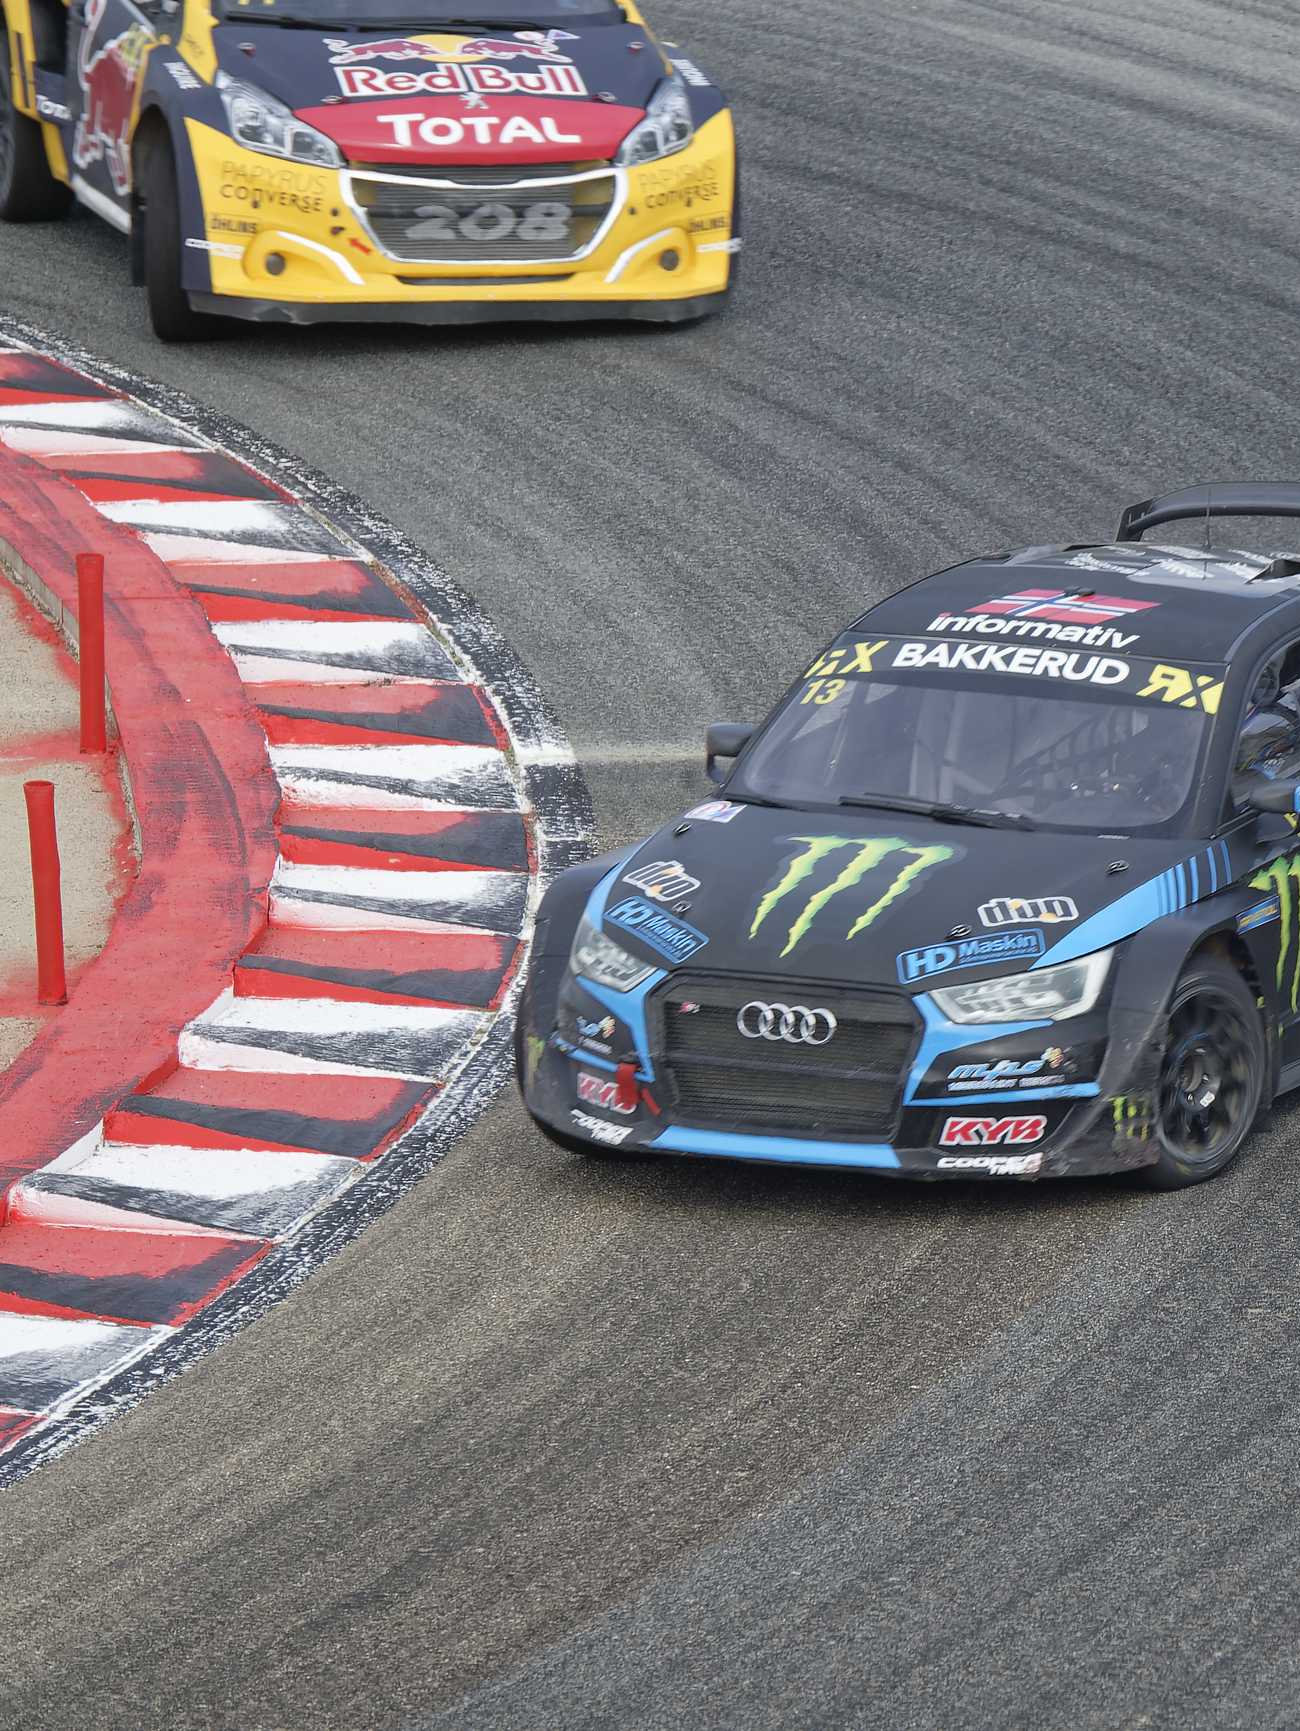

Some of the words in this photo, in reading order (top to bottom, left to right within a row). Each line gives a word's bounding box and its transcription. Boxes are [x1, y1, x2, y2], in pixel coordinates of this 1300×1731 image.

[335, 64, 468, 96] Red
[468, 63, 590, 95] Bull
[377, 113, 582, 146] TOTAL
[405, 202, 573, 242] 208
[926, 612, 1140, 649] informativ
[892, 642, 1130, 686] BAKKERUD
[800, 679, 846, 705] 13
[906, 946, 956, 979] HD
[959, 934, 1037, 957] Maskin
[939, 1114, 1048, 1146] KYB
